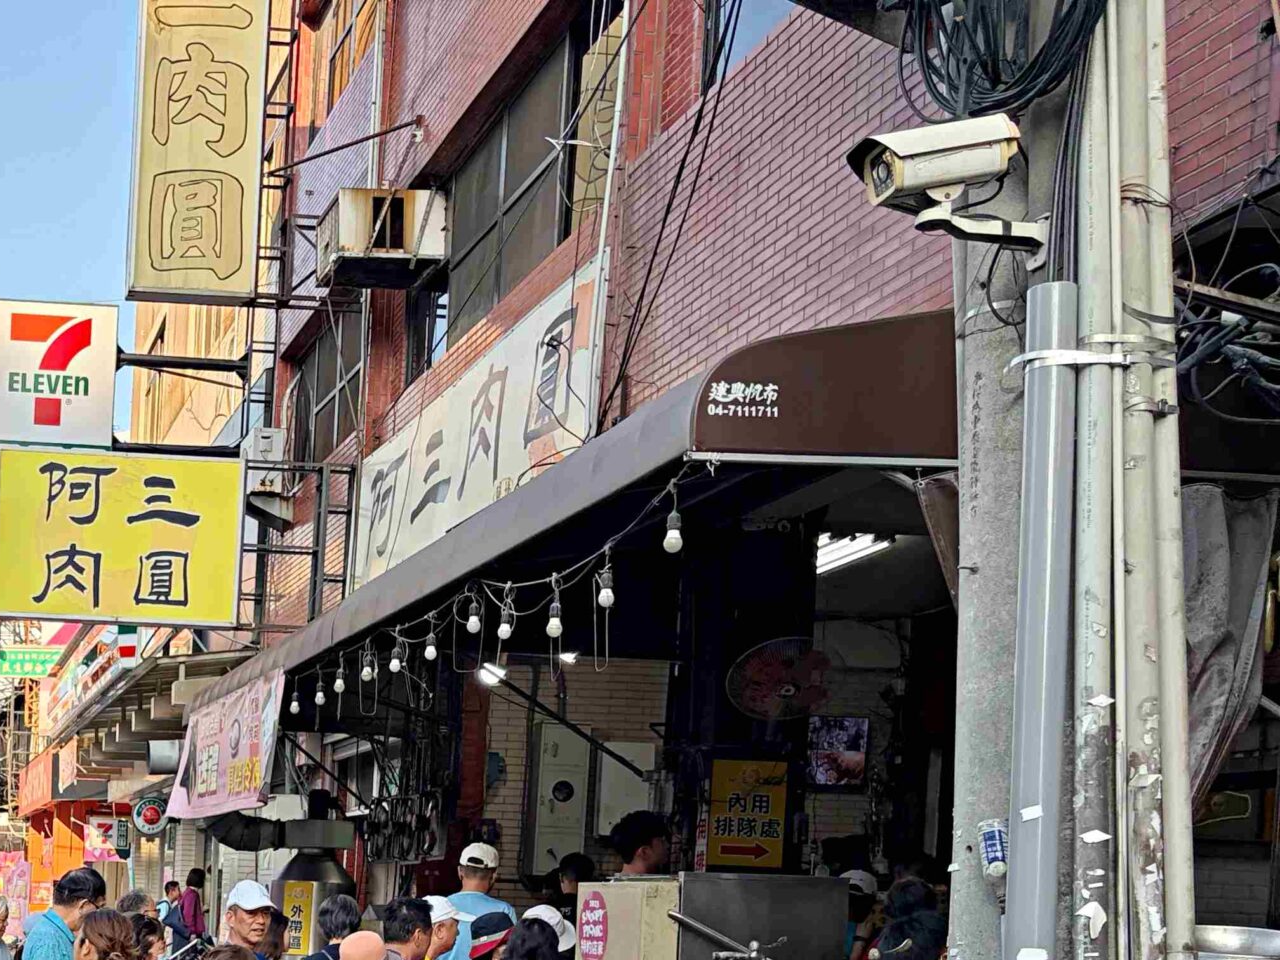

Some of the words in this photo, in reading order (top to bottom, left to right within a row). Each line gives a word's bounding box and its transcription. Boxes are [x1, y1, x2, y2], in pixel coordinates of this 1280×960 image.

[707, 403, 779, 418] 04-7111711
[38, 462, 201, 526] 阿三
[32, 543, 189, 609] 肉圓
[727, 793, 770, 815] 內用
[714, 816, 781, 839] 排隊處
[288, 904, 304, 949] 外帶區
